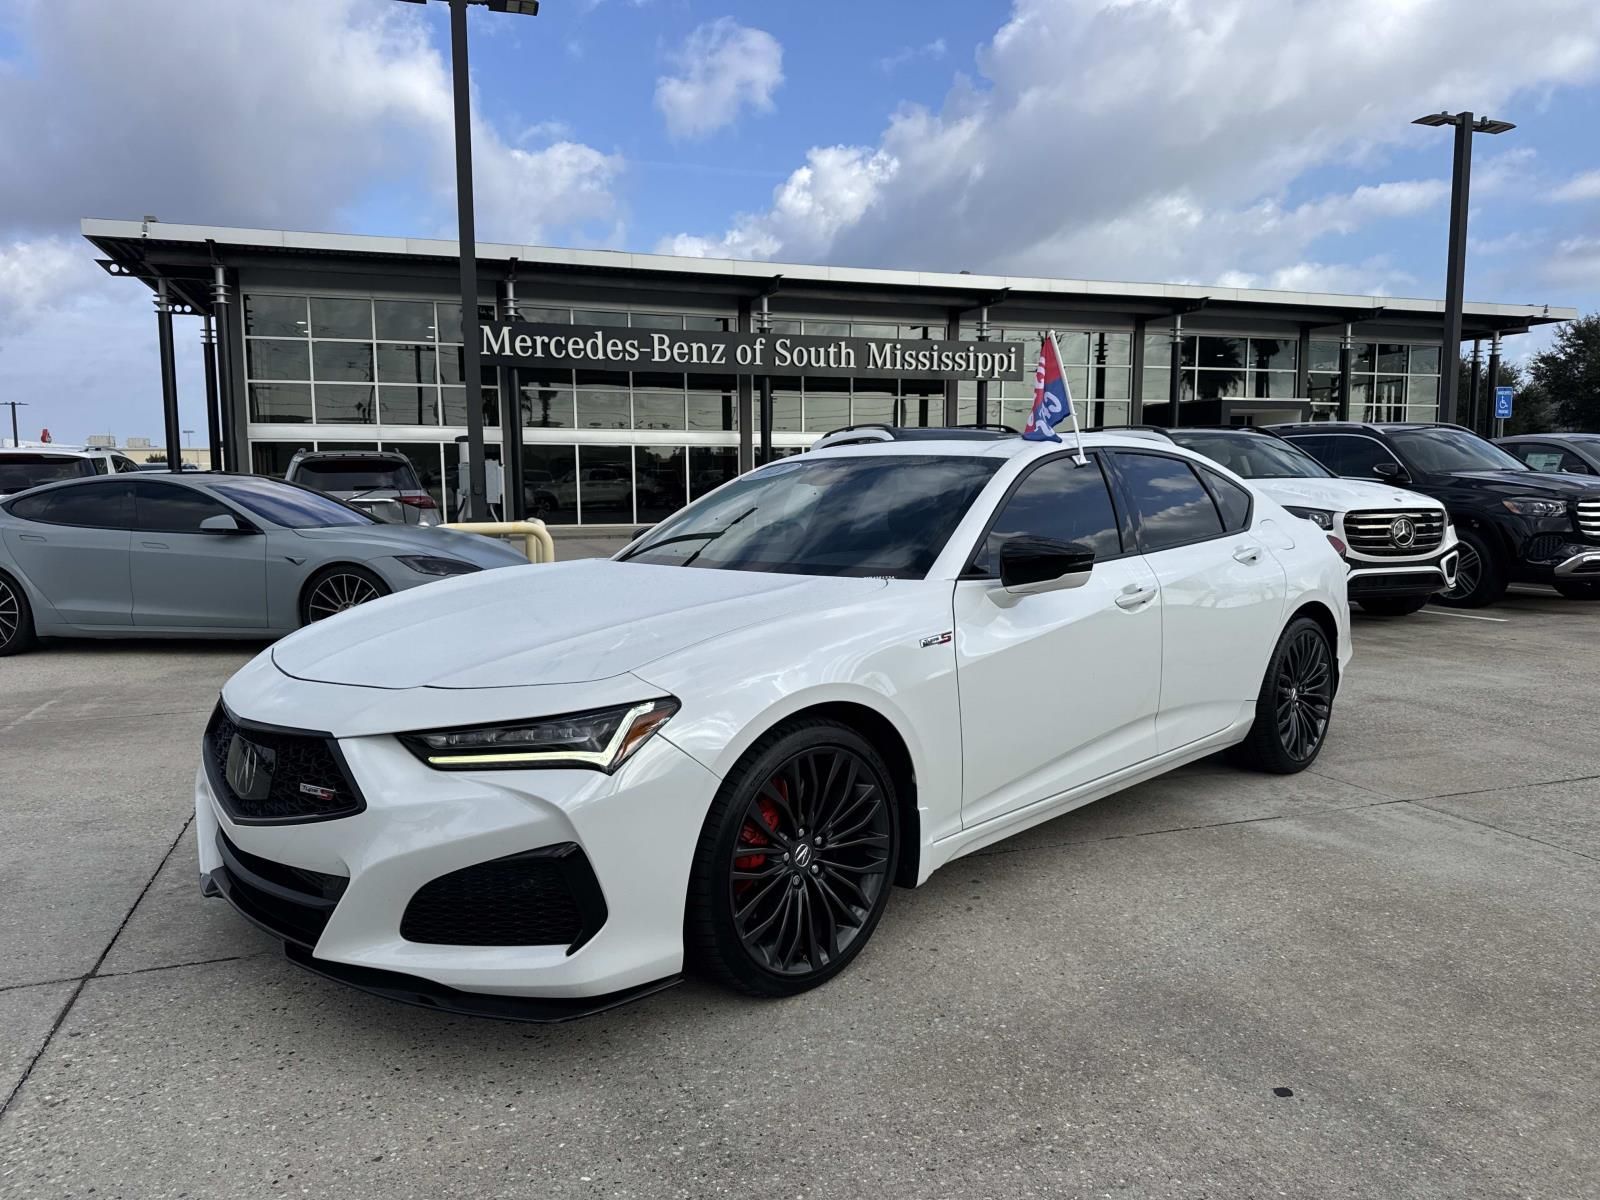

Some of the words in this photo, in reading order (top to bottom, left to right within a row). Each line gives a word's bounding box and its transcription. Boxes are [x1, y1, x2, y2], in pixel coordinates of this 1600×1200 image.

[480, 325, 727, 365] Mercedes-Benz
[736, 338, 766, 366] of
[775, 339, 857, 369] South
[867, 342, 1017, 379] Mississippi
